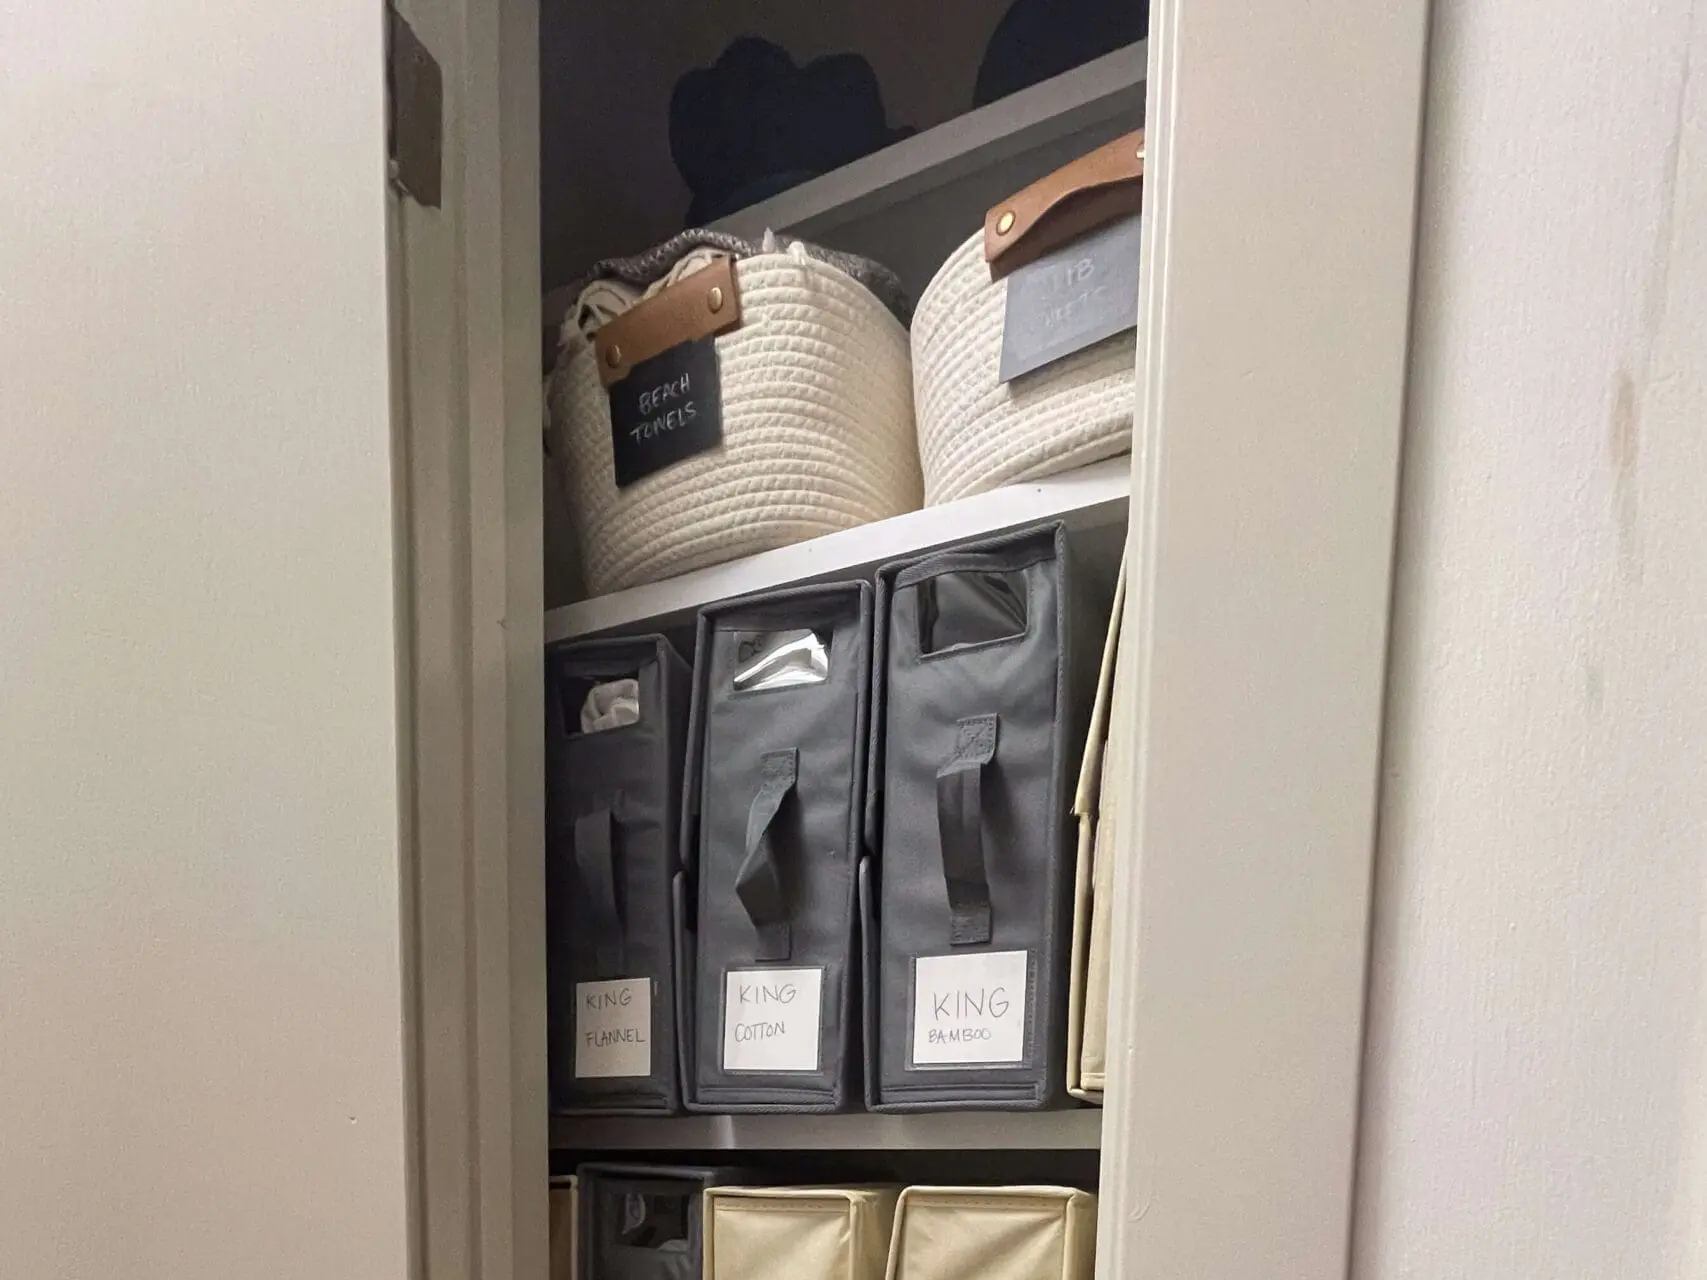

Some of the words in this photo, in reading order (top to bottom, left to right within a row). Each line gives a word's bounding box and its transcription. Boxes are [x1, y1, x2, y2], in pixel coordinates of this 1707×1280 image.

[639, 373, 690, 415] BEACH
[629, 401, 697, 444] TOWELS
[586, 988, 632, 1010] KING
[739, 983, 796, 1005] KING
[933, 987, 1009, 1020] KING
[585, 1028, 645, 1048] FLANNEL
[735, 1021, 786, 1043] COTTON
[928, 1028, 991, 1045] BAMBOO
